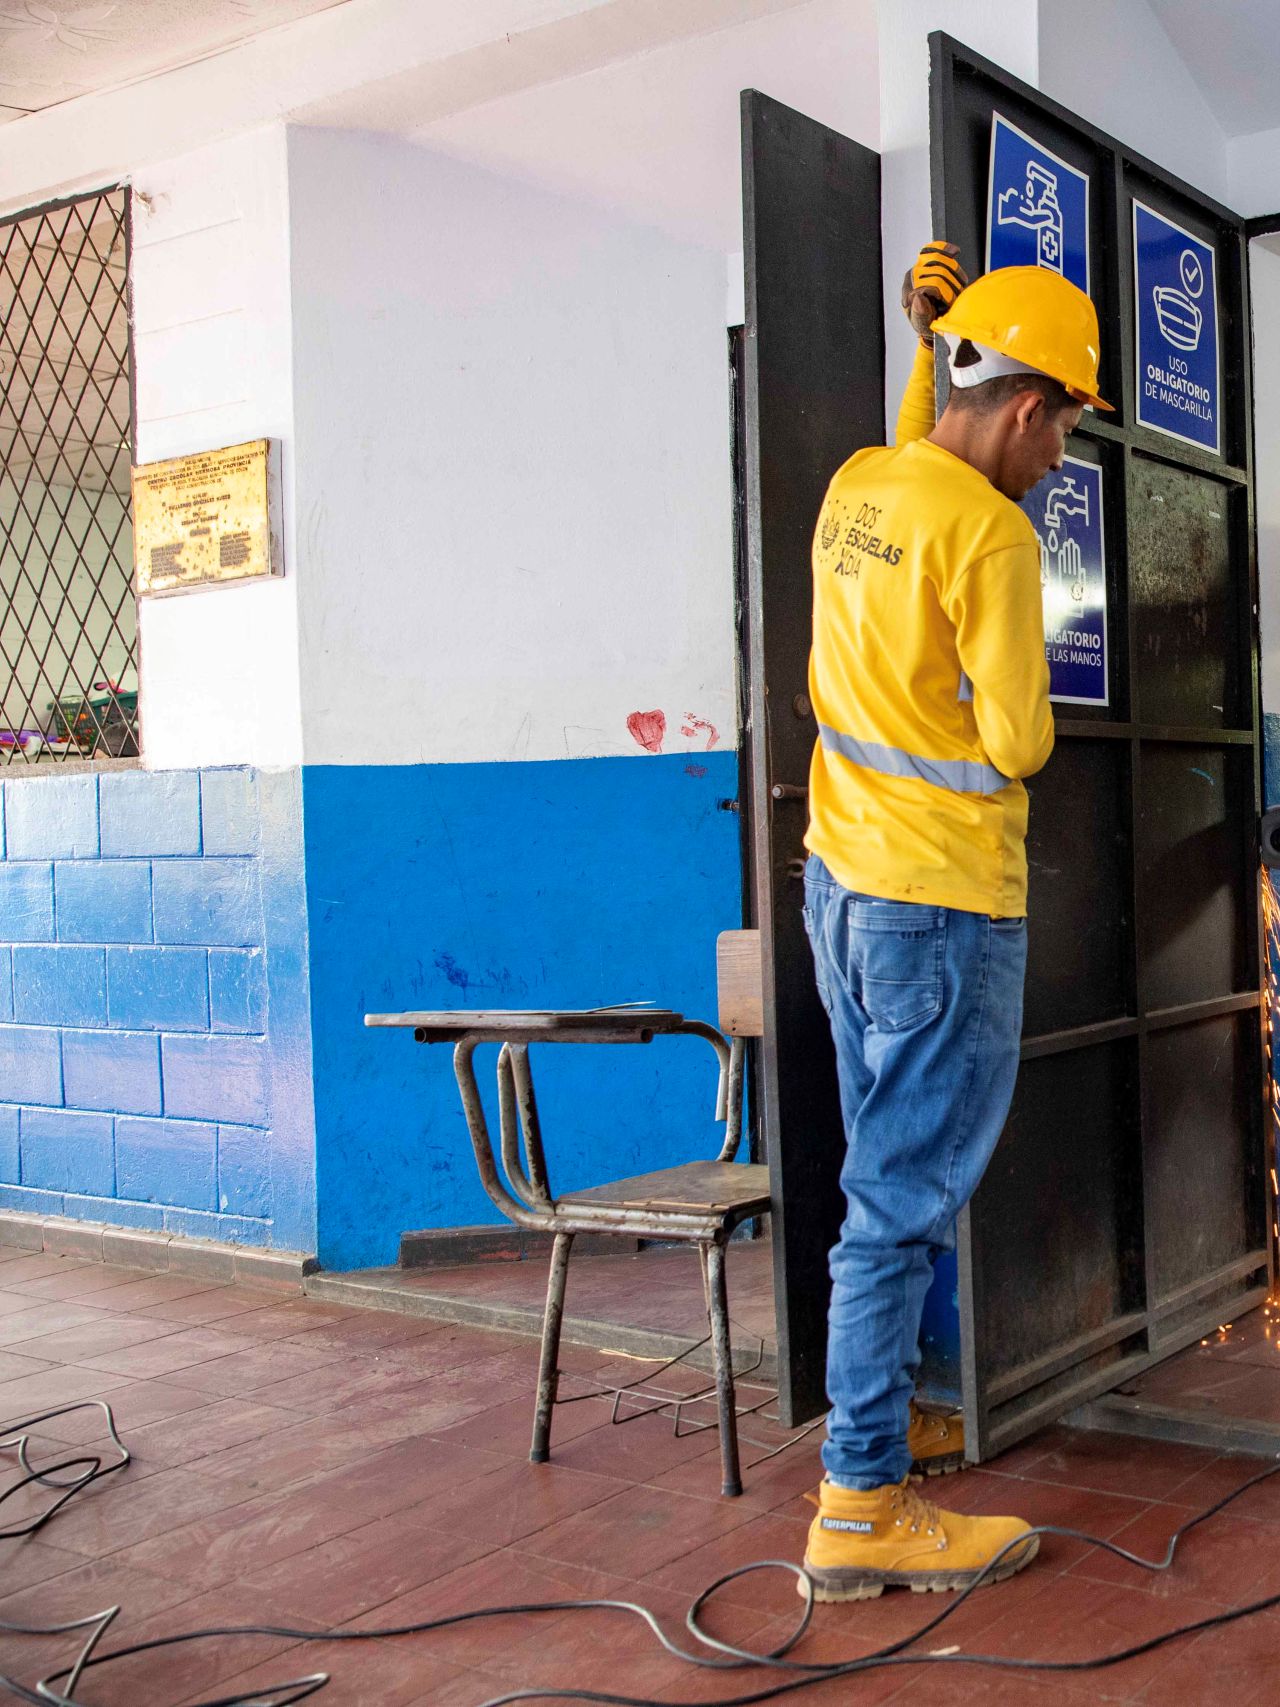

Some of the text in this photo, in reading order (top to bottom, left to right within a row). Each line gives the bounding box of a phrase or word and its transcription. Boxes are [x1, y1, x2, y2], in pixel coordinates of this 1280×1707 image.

[1168, 355, 1188, 375] USO
[1147, 364, 1210, 403] OBLIGATORIO
[1145, 381, 1213, 422] DE MASCARILLA
[855, 502, 882, 529] DOS
[845, 527, 903, 566] ESCUELAS
[1045, 629, 1101, 649] LIGATORIO
[1045, 647, 1102, 667] E LAS MANOS
[823, 1518, 872, 1531] CATERPILLAR
